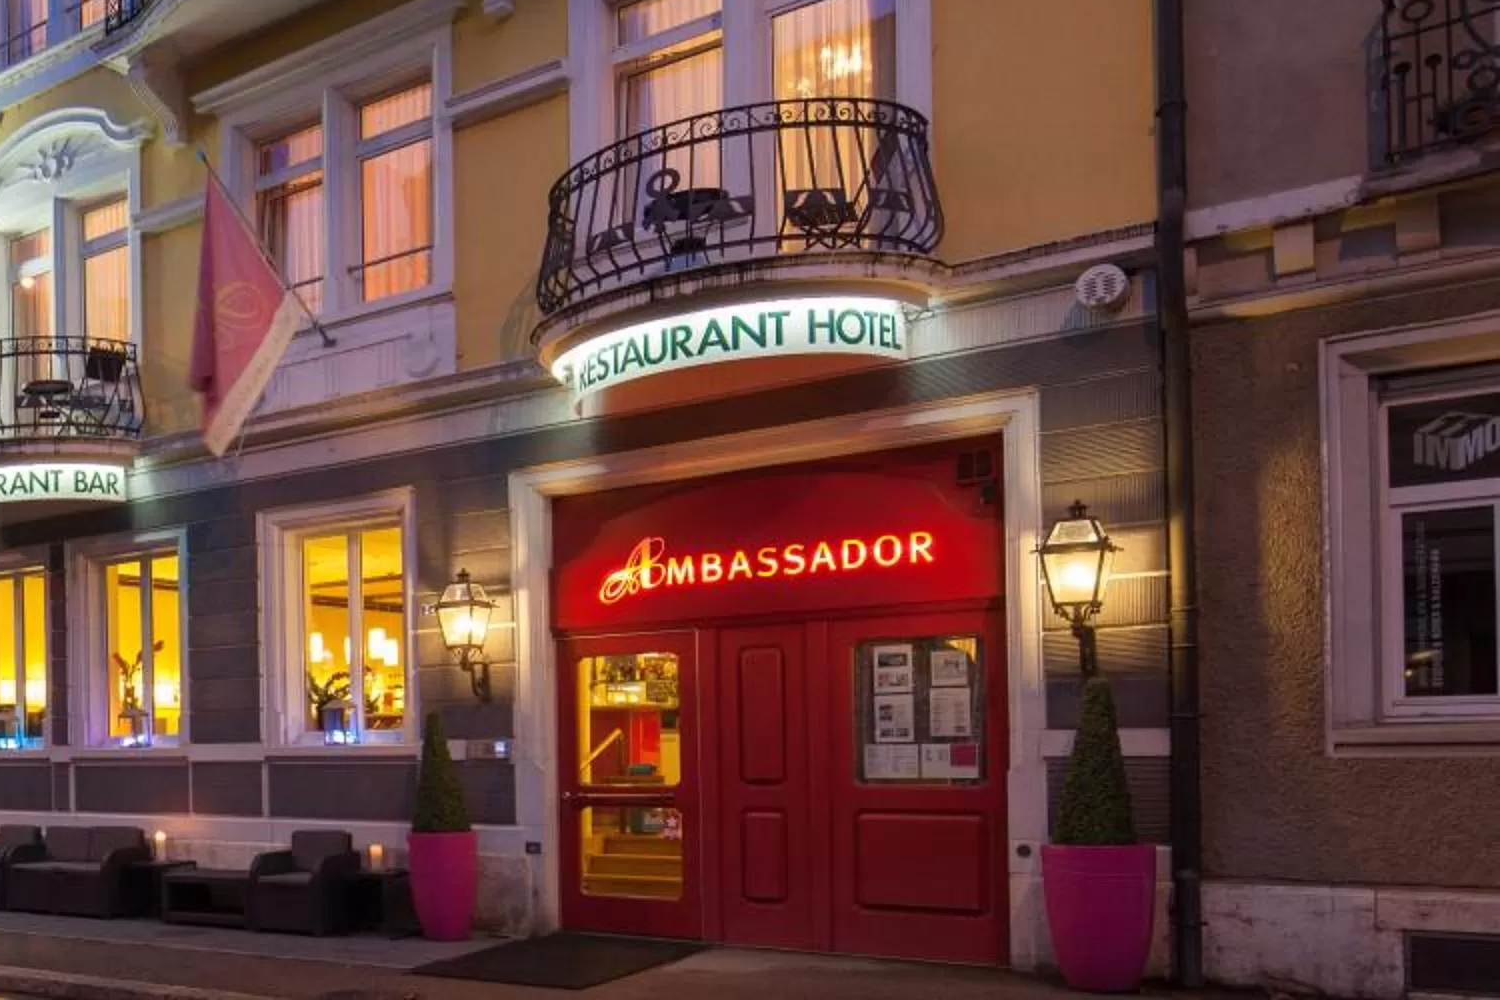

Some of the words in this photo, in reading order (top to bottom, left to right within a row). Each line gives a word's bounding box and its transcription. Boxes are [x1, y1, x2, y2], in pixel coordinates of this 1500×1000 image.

[579, 310, 791, 393] RESTAURANT
[807, 308, 903, 351] HOTEL
[73, 469, 120, 496] BAR
[599, 531, 934, 605] AMBASSADOR
